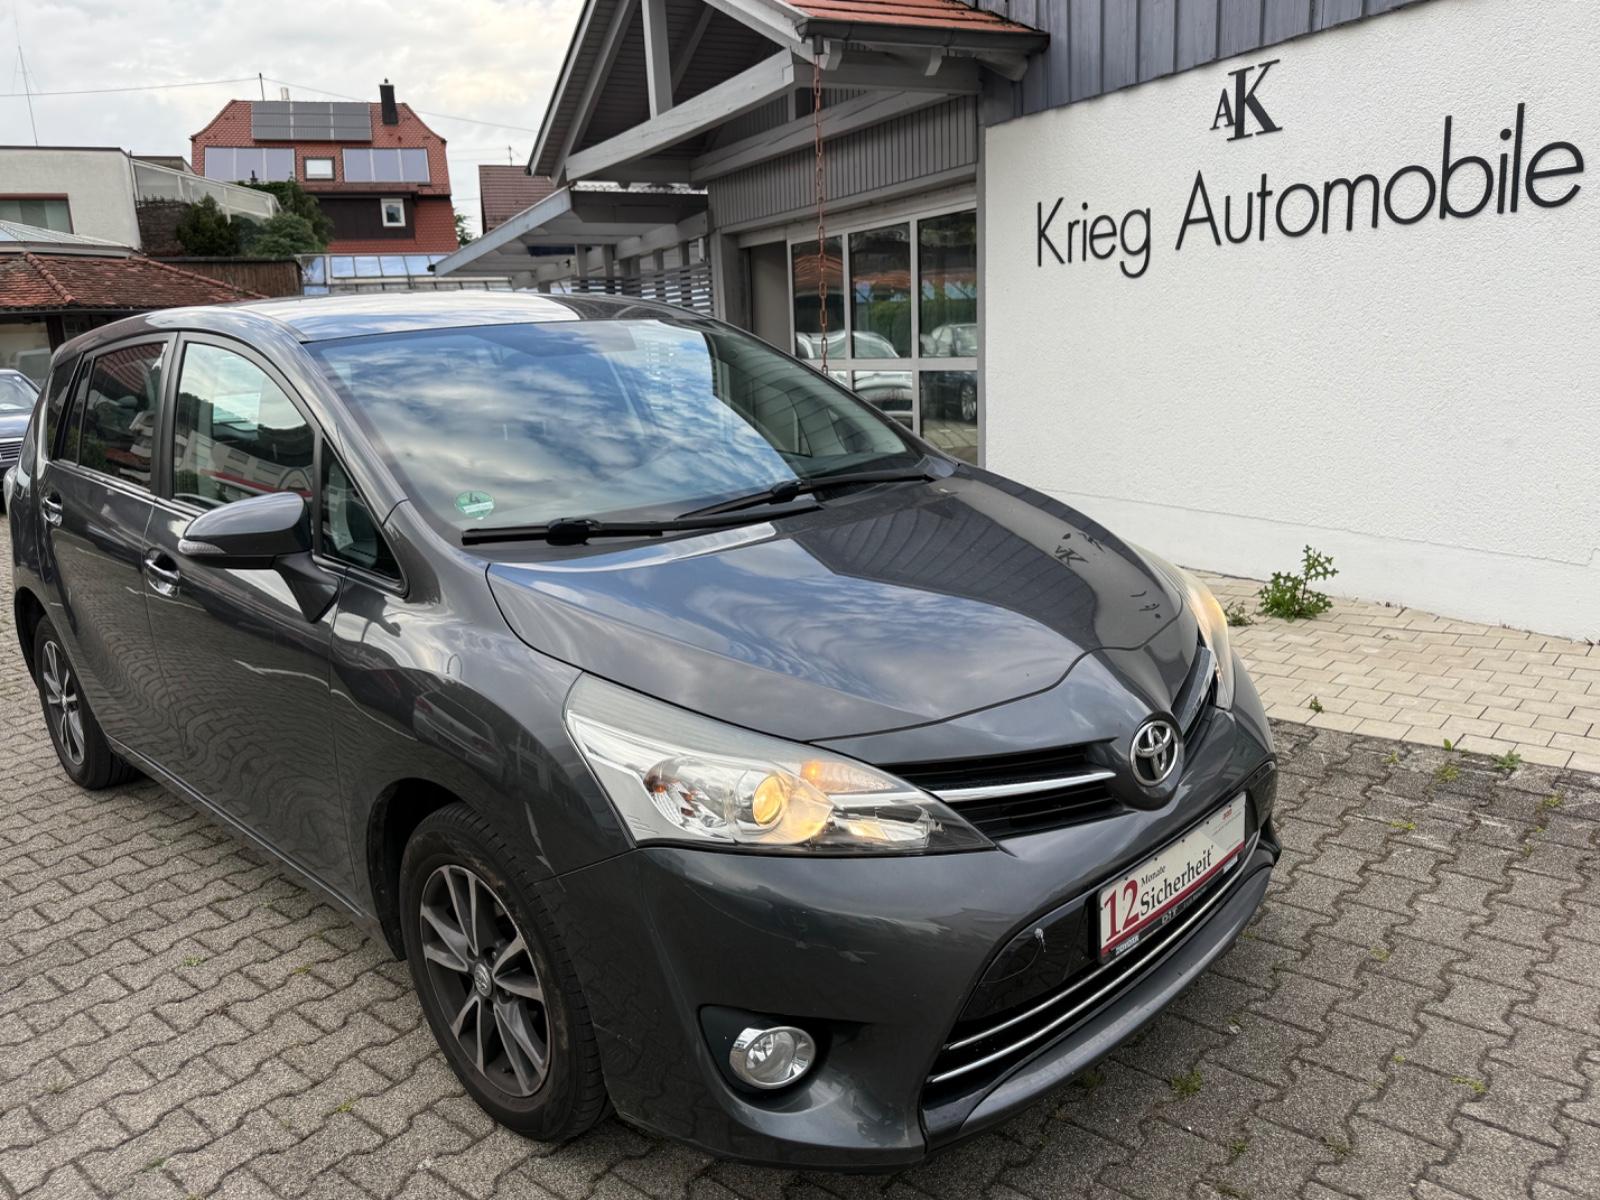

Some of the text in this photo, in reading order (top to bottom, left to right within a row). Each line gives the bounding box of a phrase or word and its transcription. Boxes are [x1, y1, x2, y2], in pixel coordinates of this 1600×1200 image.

[1210, 59, 1283, 142] AK
[1037, 103, 1584, 279] Krieg Automobile
[1104, 879, 1140, 942] 12
